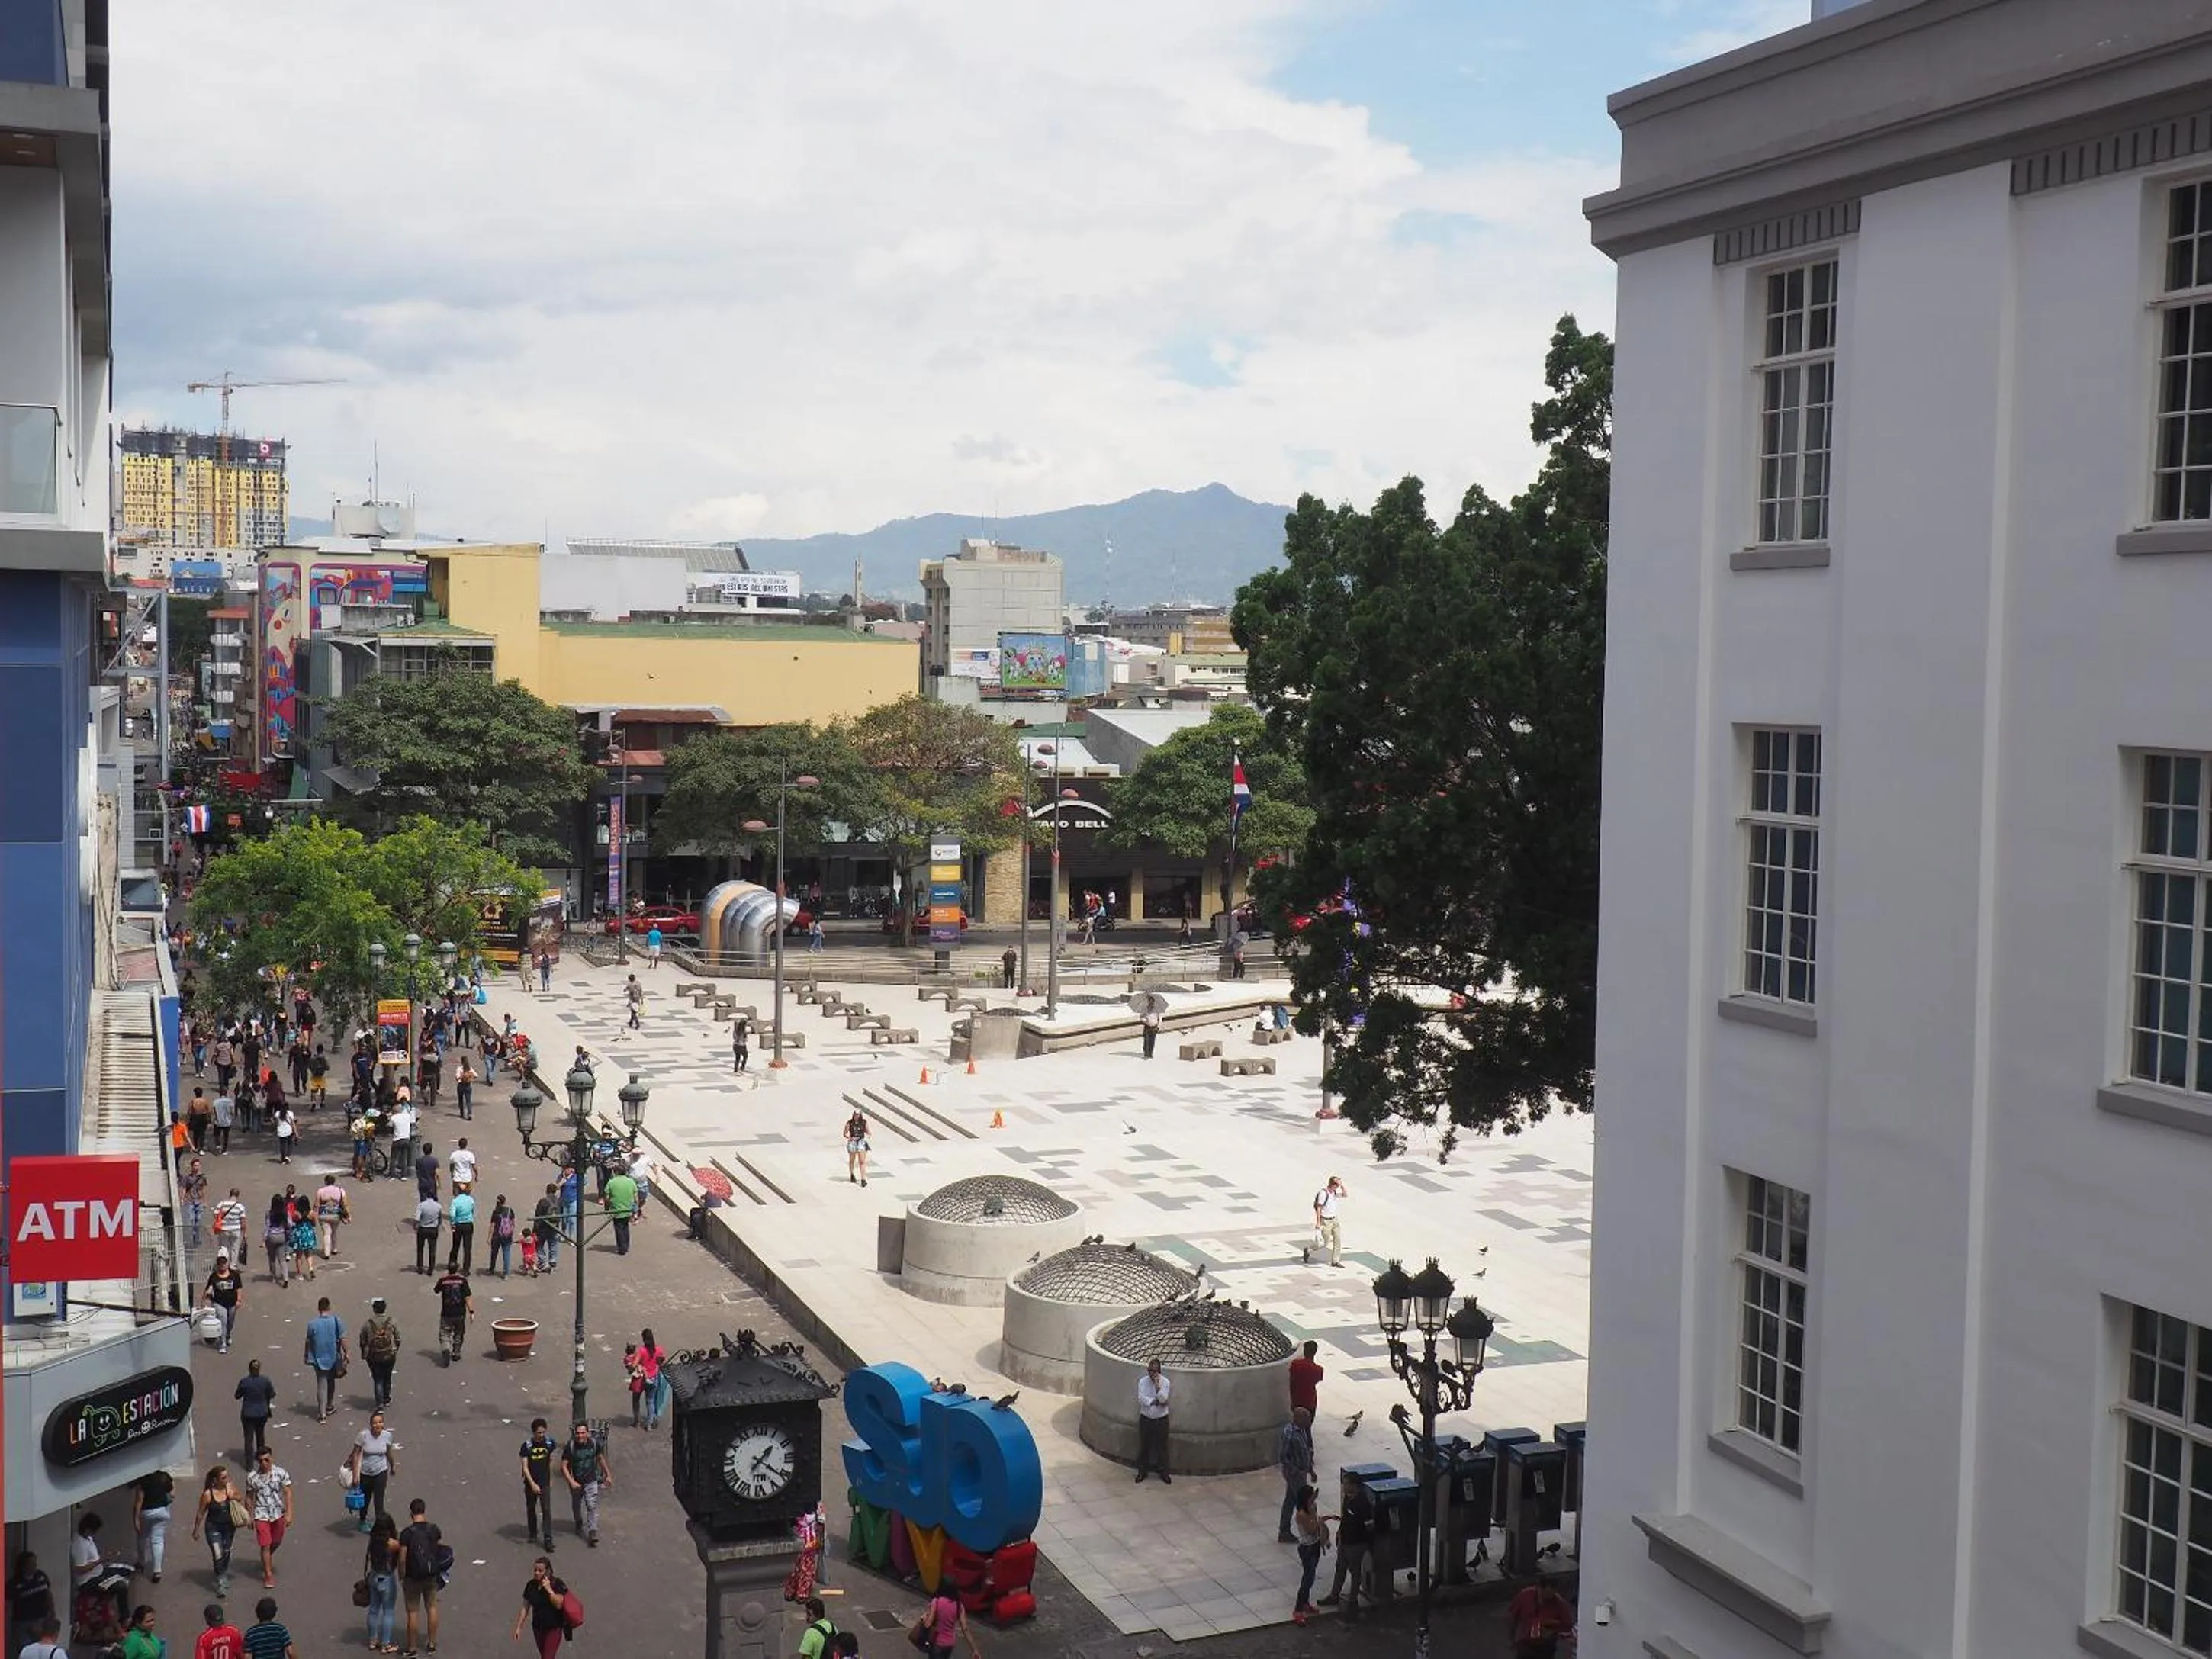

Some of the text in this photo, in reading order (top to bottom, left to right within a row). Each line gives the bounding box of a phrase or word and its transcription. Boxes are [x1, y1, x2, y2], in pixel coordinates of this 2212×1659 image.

[1075, 820, 1109, 828] BELL
[17, 1199, 133, 1242] ATM
[70, 1374, 179, 1445] LA ESTACIÓN
[212, 1645, 229, 1659] 10
